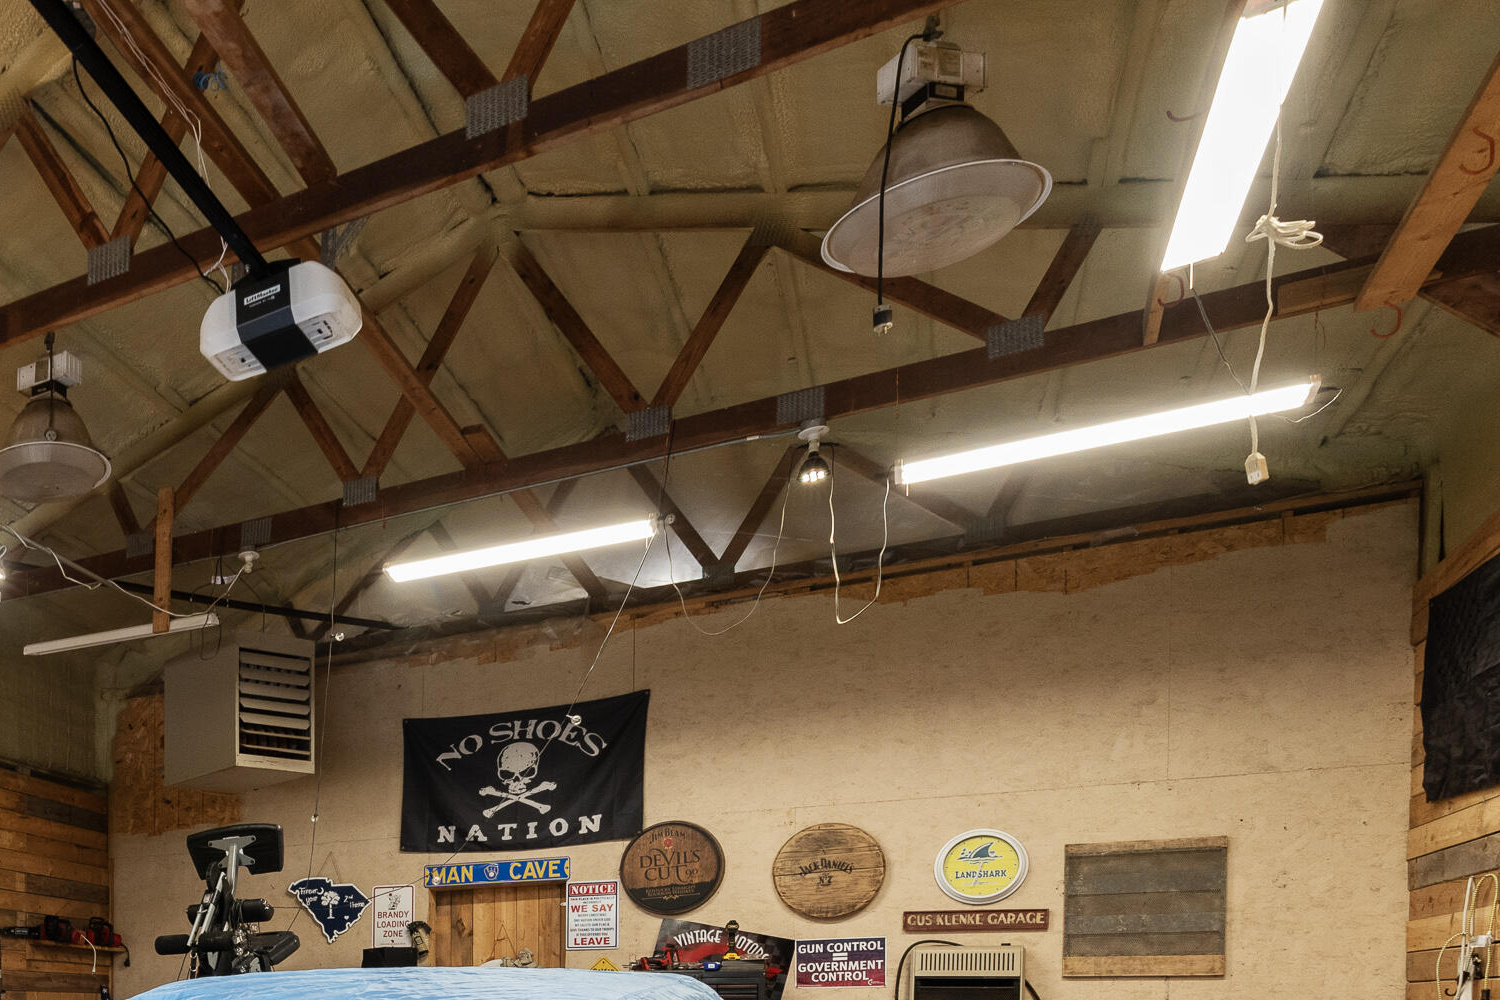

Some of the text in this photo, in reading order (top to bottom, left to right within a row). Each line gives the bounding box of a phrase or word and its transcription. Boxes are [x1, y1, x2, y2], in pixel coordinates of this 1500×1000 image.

[436, 718, 608, 771] NO SHOES
[437, 813, 603, 843] NATION
[649, 828, 687, 845] JIM BEAM
[640, 848, 701, 869] DEVIL'S
[431, 859, 561, 885] MAN CAVE
[644, 864, 688, 883] CUT
[799, 861, 821, 877] JACK
[571, 883, 615, 895] NOTICE
[377, 910, 410, 919] BRANDY
[570, 903, 614, 913] WE SAY
[376, 920, 411, 929] LOADING
[907, 912, 1045, 926] GUS KLENKE GARAGE
[382, 930, 404, 938] ZONE
[573, 936, 611, 946] LEAVE
[673, 929, 723, 948] VINTAGE
[798, 940, 884, 954] GUN CONTROL
[797, 960, 884, 973] GOVERNMENT
[811, 971, 870, 983] CONTROL
